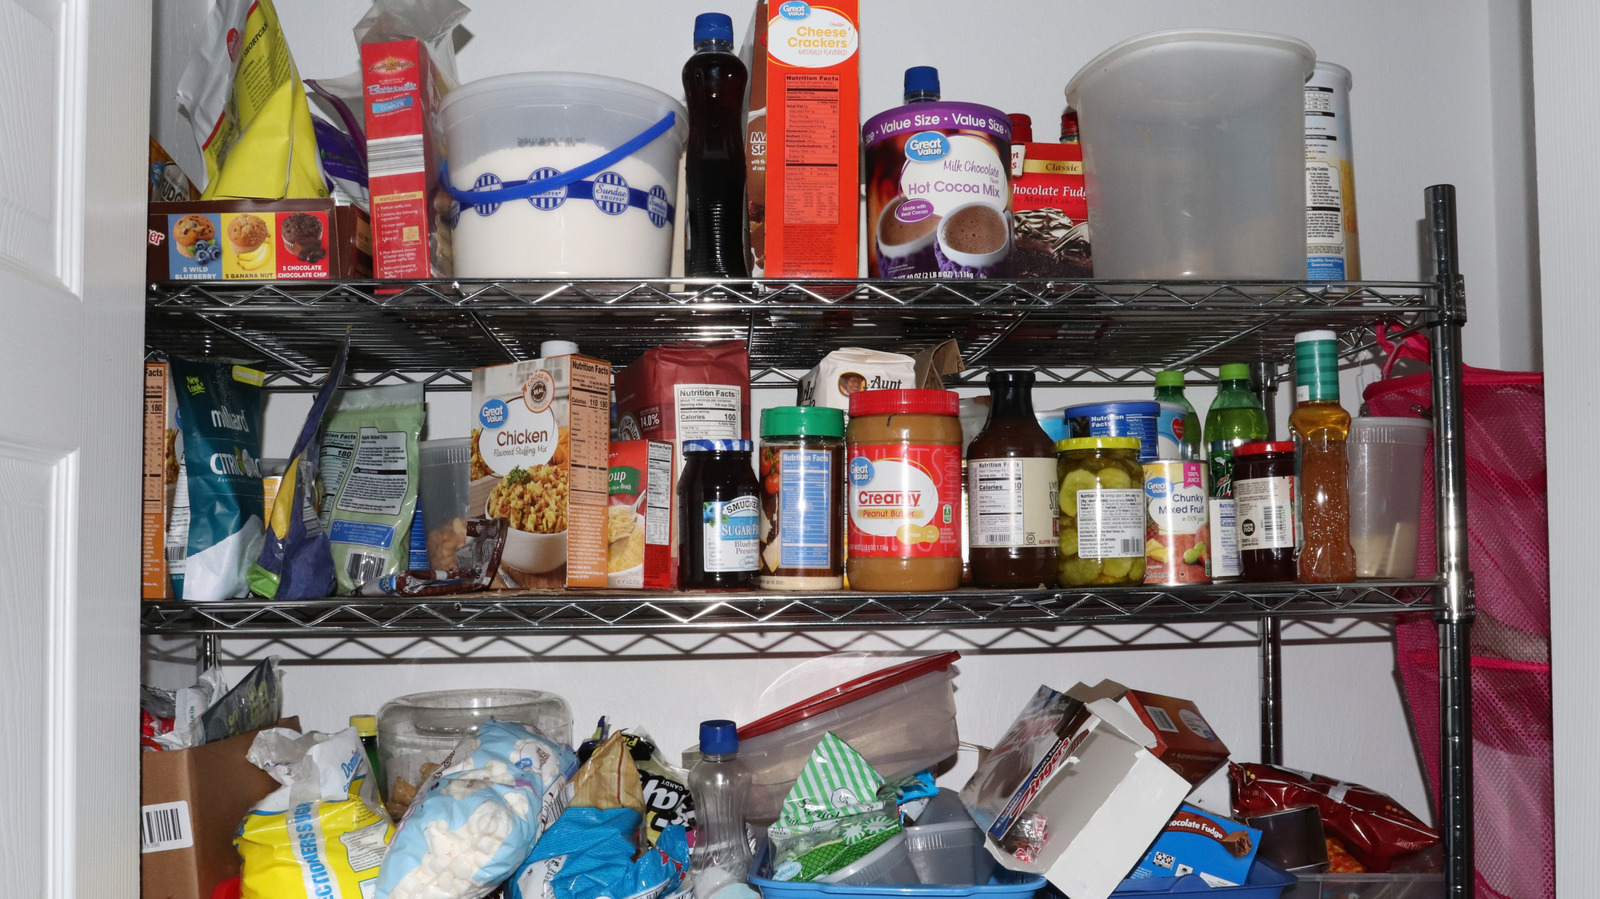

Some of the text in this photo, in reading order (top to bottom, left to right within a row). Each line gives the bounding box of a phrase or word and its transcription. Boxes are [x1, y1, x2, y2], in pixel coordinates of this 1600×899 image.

[797, 26, 847, 37] Cheese
[787, 37, 847, 48] Crackers
[880, 112, 1004, 135] Value Size Value Size
[910, 138, 942, 150] Great
[917, 147, 941, 156] Value
[943, 160, 962, 172] Milk
[964, 160, 999, 178] Chocolate
[1045, 163, 1079, 172] Classic
[596, 184, 627, 198] Sundae
[908, 180, 1000, 199] Hot Cocoa Mix
[1012, 184, 1059, 196] hocolate
[600, 194, 625, 202] SHOPPE
[149, 229, 165, 247] er
[572, 360, 609, 376] Nutrition Facts
[186, 375, 199, 384] New
[870, 375, 903, 390] Aunt
[680, 389, 736, 398] Nutrition Facts
[151, 404, 163, 412] 180
[589, 398, 599, 407] 110
[482, 405, 504, 417] Great
[724, 413, 736, 421] 100
[211, 404, 250, 433] milliard
[486, 415, 504, 424] Value
[640, 412, 660, 428] 14.0%
[496, 428, 548, 447] Chicken
[337, 450, 352, 458] 180
[493, 444, 548, 457] Flavored Stuffing Mix
[812, 453, 829, 462] Facts
[850, 463, 869, 474] Great
[608, 471, 626, 483] oup
[858, 490, 921, 507] Creamy
[1172, 493, 1204, 504] Chunky
[863, 509, 888, 518] Peanut
[1158, 504, 1205, 515] Mxed Fruit
[721, 524, 752, 536] SUGAR
[340, 749, 363, 779] Domin
[1010, 736, 1071, 818] Zingers
[660, 780, 684, 792] CANDY
[1201, 823, 1223, 839] Fudge
